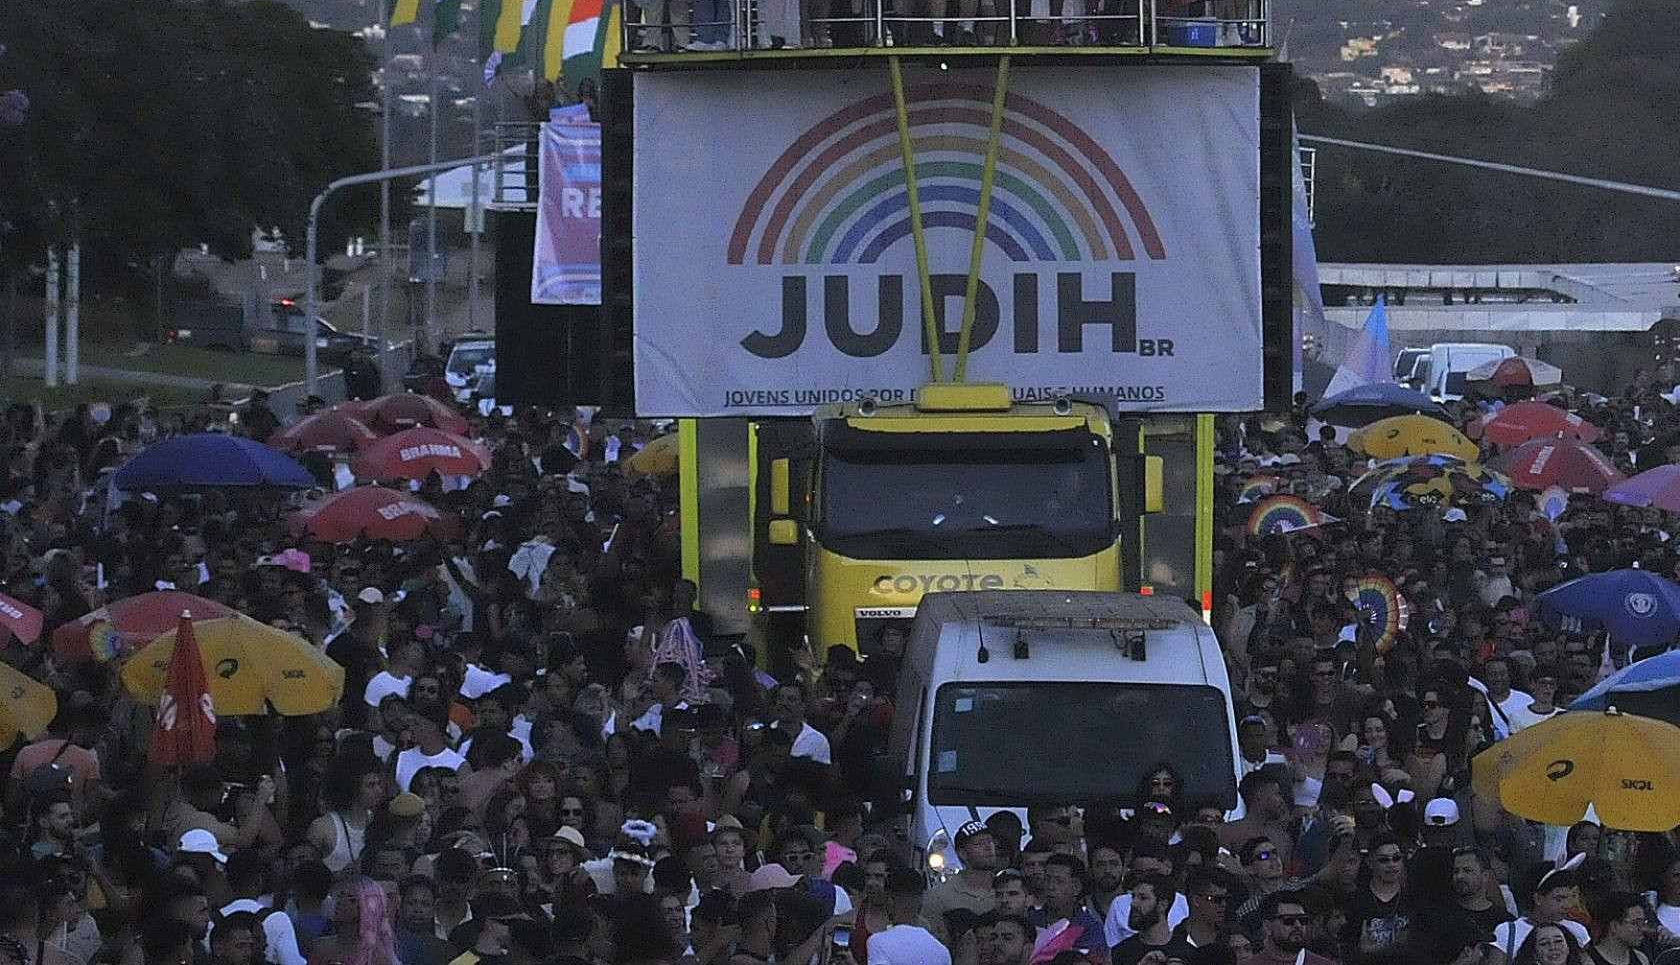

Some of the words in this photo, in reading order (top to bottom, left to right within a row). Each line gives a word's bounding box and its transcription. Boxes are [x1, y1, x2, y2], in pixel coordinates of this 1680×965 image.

[740, 272, 1136, 358] JUDIH
[1139, 339, 1175, 357] BR
[725, 390, 789, 408] JOVENS
[795, 388, 865, 404] UNIDOS
[400, 444, 462, 462] BRAHMA
